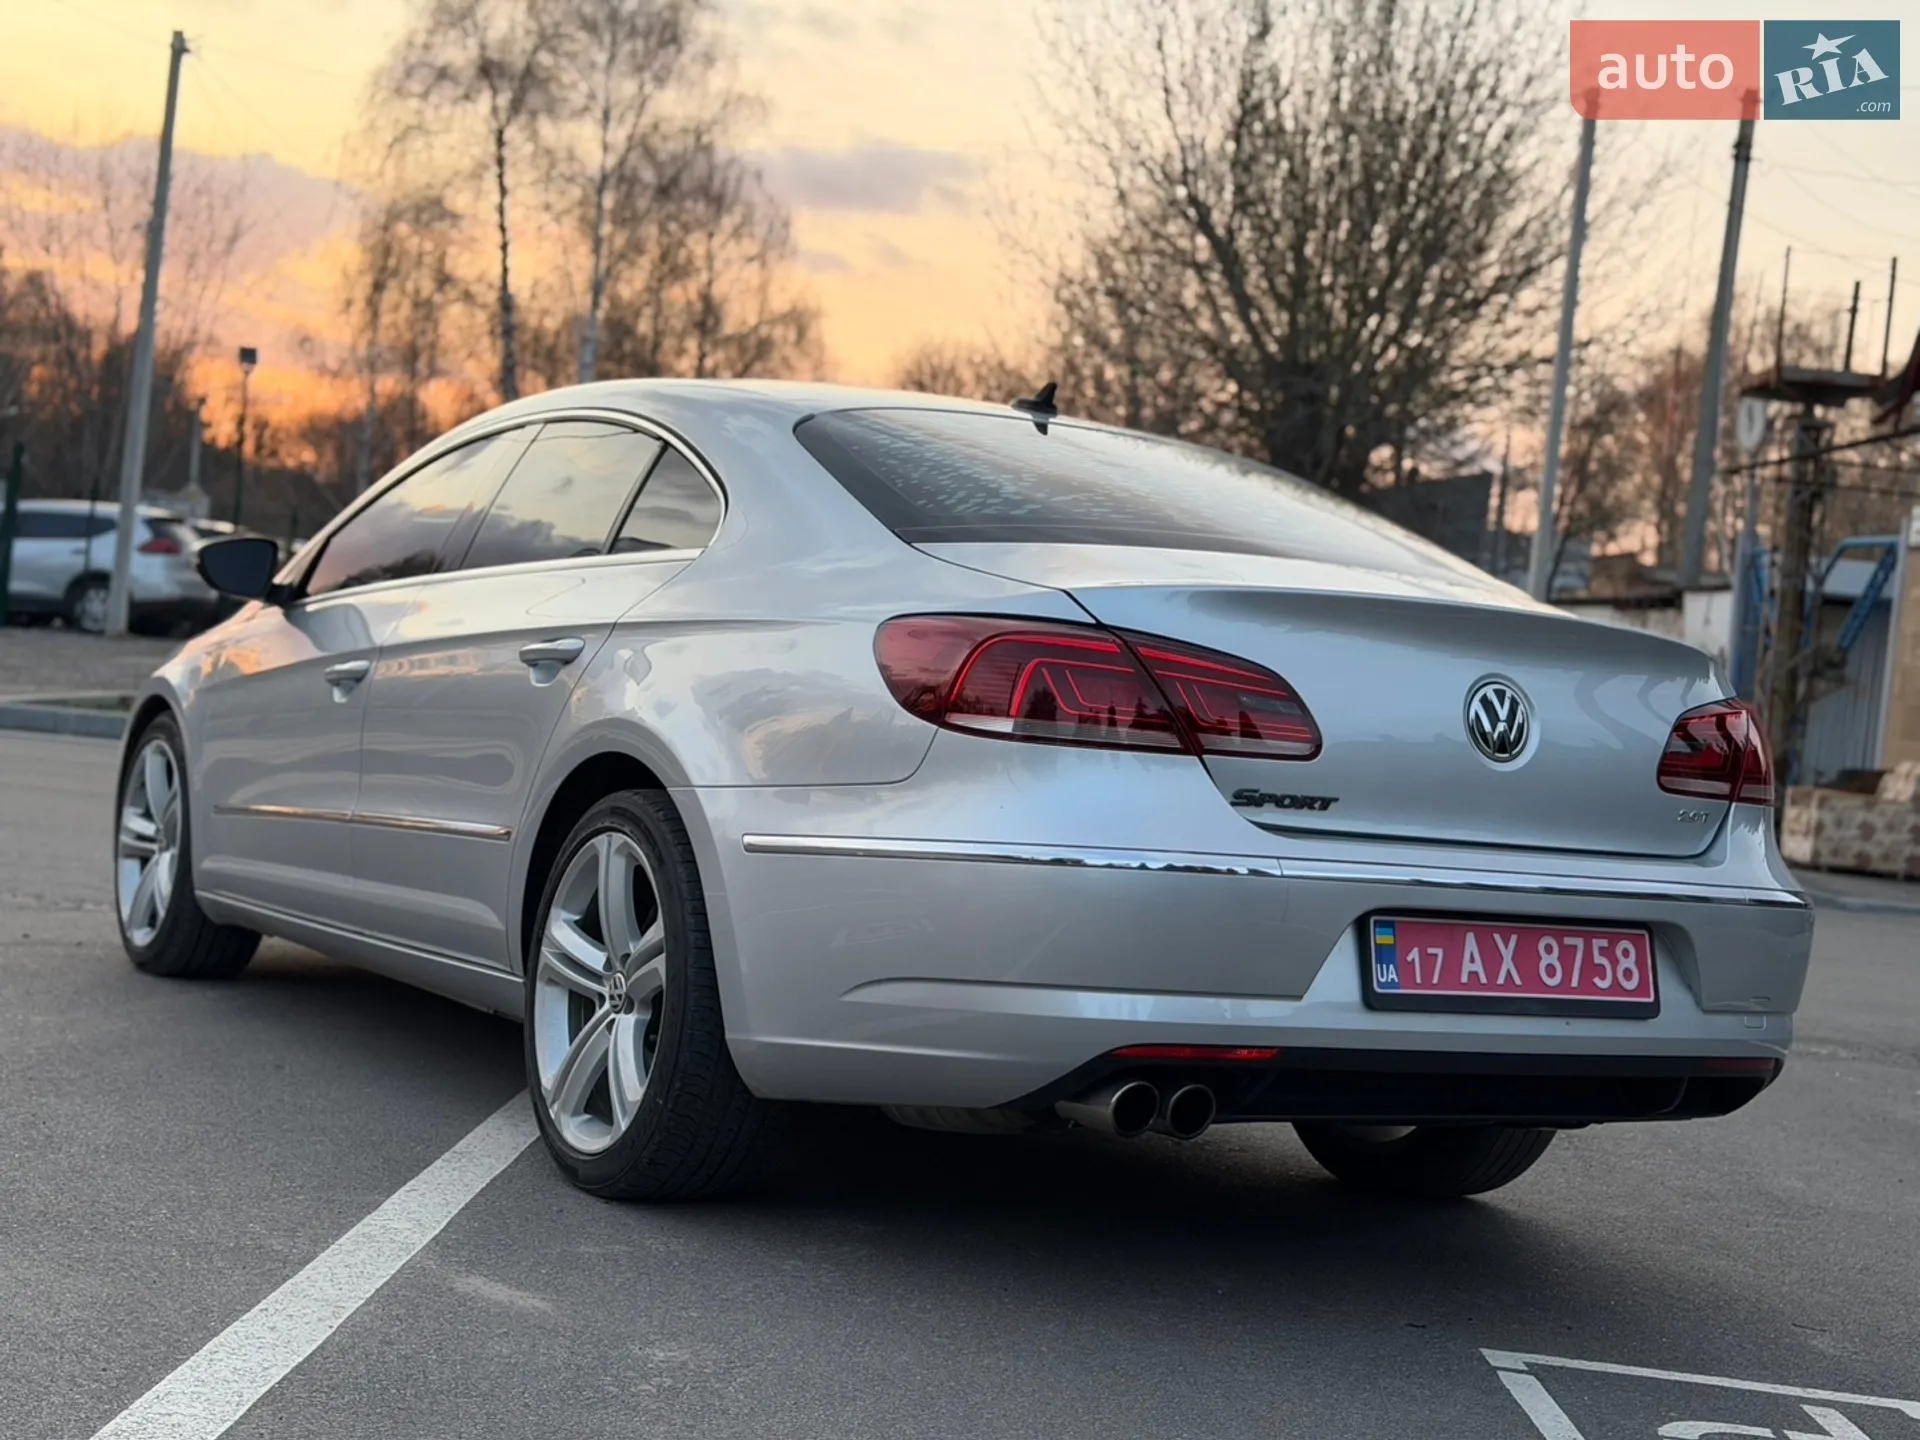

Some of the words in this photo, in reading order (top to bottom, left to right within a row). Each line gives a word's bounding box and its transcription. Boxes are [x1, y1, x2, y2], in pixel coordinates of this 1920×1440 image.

[1376, 963, 1399, 983] UA
[1405, 947, 1444, 984] 17
[1460, 931, 1523, 986] AX
[1537, 934, 1641, 992] 8758
